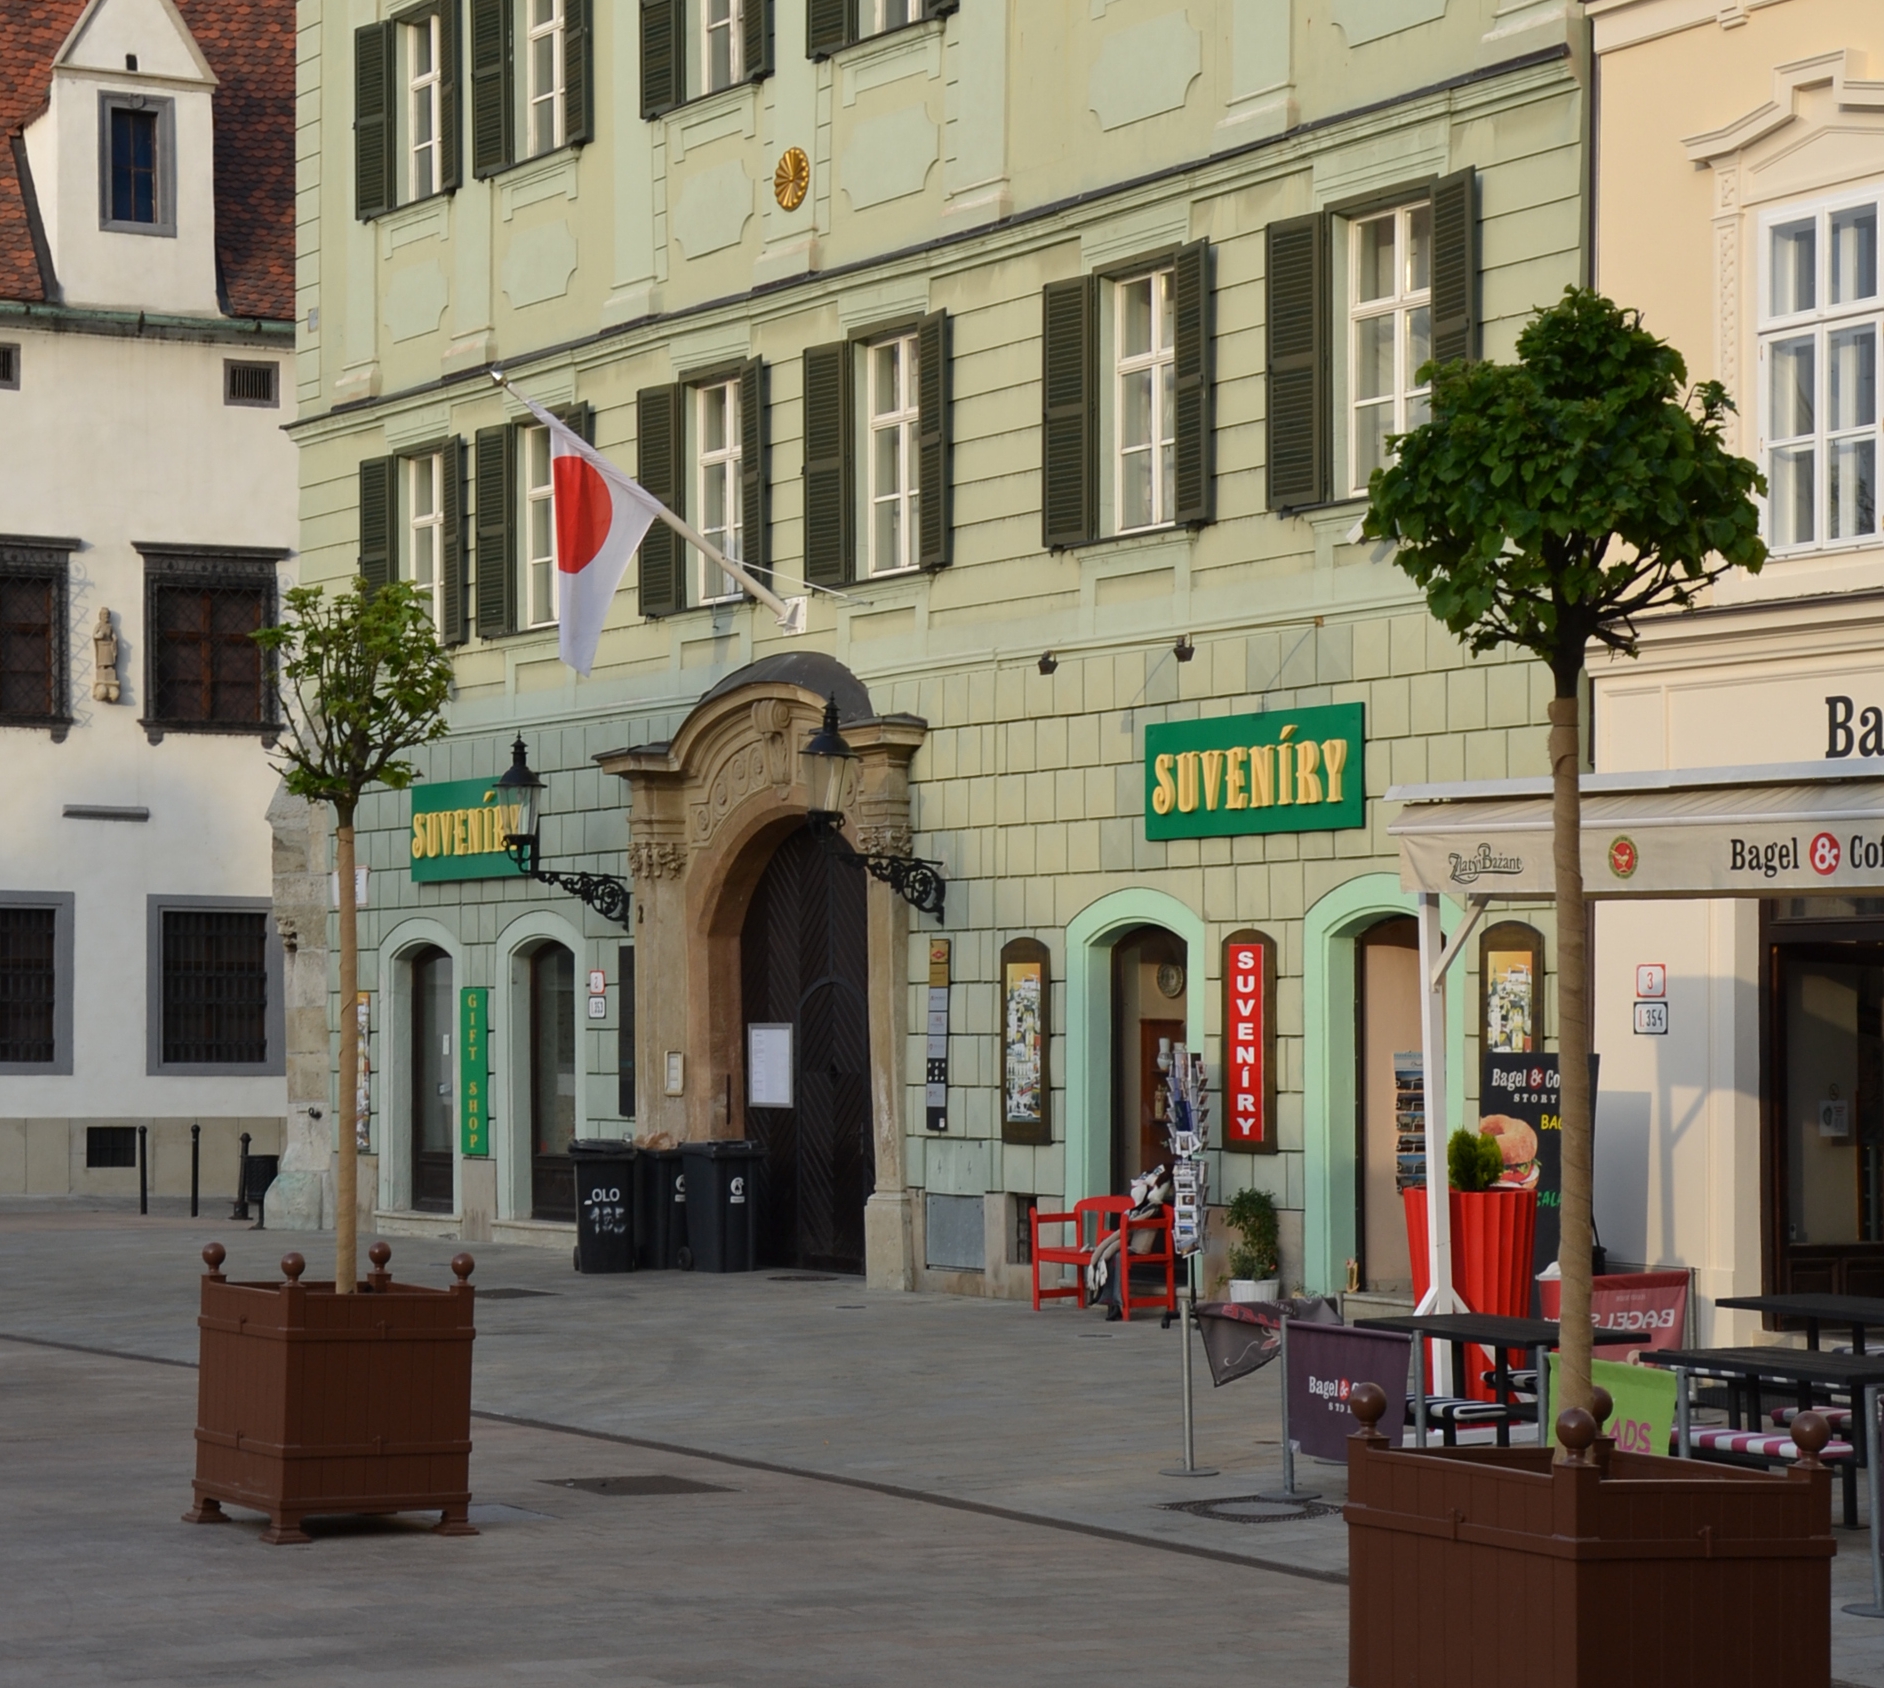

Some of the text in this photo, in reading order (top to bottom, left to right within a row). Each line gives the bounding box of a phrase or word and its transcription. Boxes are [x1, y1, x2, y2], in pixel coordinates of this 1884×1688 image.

[1152, 725, 1348, 815] SUVENÍRY
[1448, 842, 1522, 884] Zlatý Bažant
[1730, 837, 1799, 878] Bagel
[1814, 837, 1838, 870] &
[1647, 971, 1653, 990] 3
[1236, 951, 1256, 1136] SUVENÍRY
[468, 994, 478, 1148] GIFT SHOP
[1491, 1068, 1527, 1091] Bagel
[1530, 1068, 1543, 1087] &
[1513, 1093, 1557, 1104] STORY
[592, 1188, 620, 1202] OLO
[1309, 1375, 1338, 1399] Bagel
[1340, 1380, 1349, 1398] &
